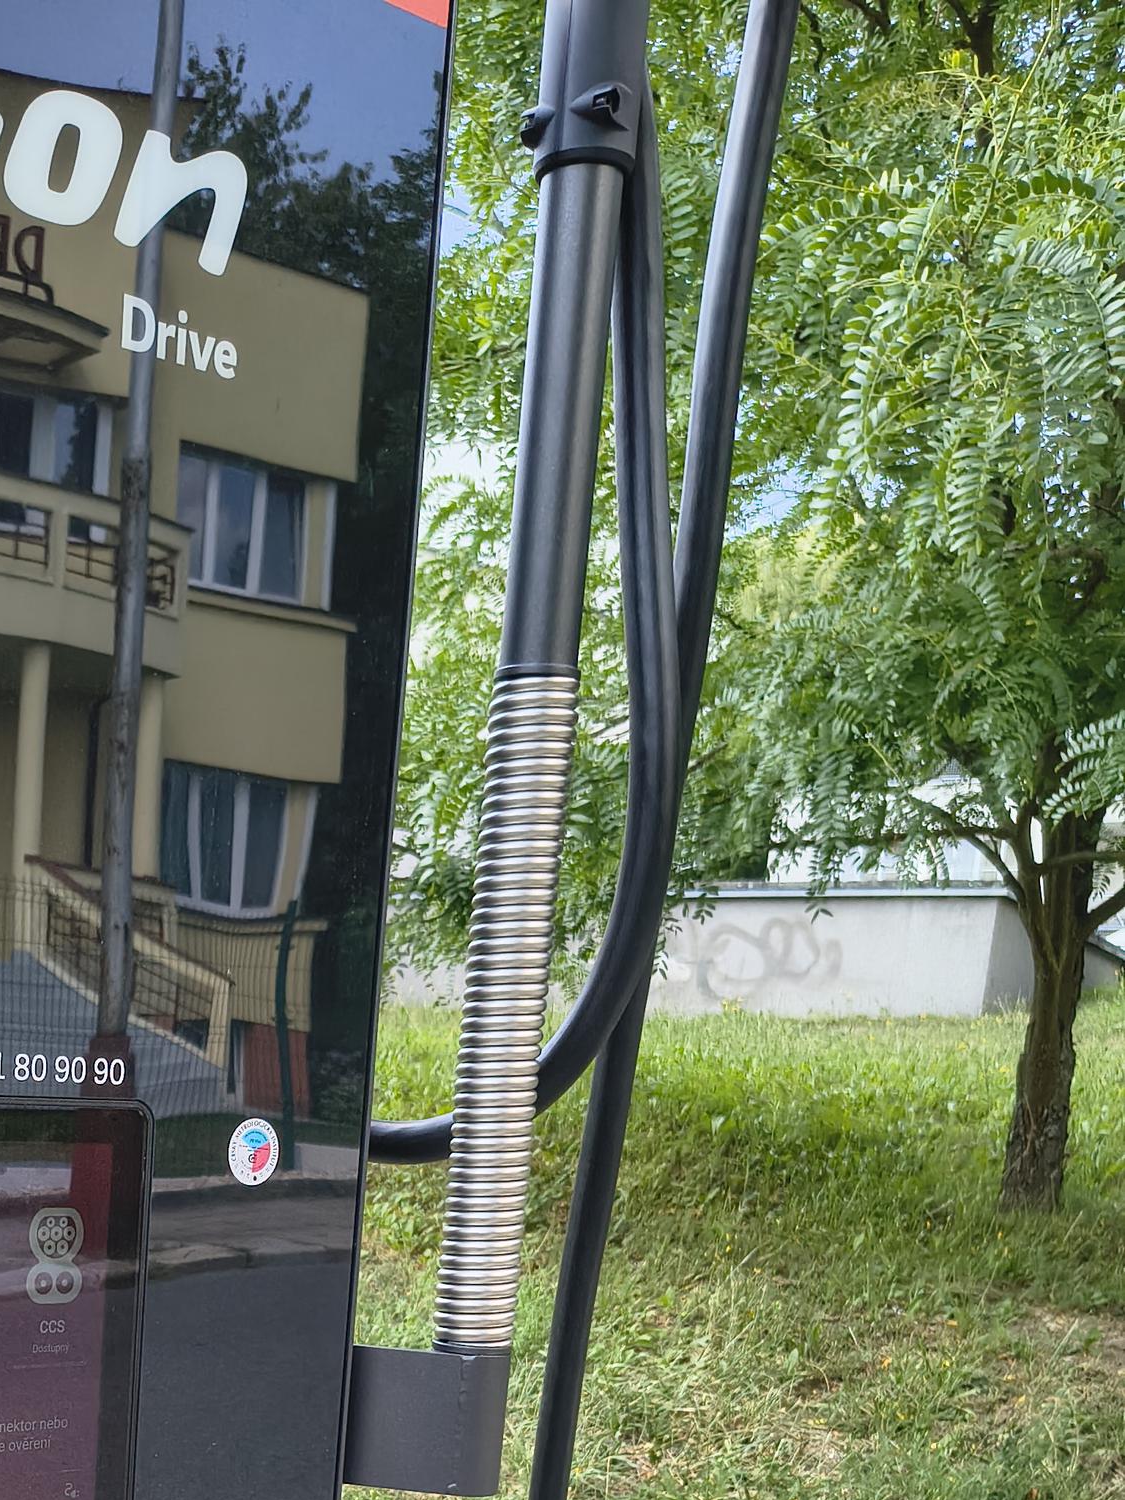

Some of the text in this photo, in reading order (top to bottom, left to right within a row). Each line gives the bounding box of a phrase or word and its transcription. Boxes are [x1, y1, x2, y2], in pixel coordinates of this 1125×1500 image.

[121, 293, 238, 380] Drive
[14, 1053, 47, 1082] 80
[54, 1055, 87, 1084] 90
[93, 1057, 125, 1086] 90
[40, 1320, 66, 1334] CCS
[39, 1415, 69, 1430] nebo
